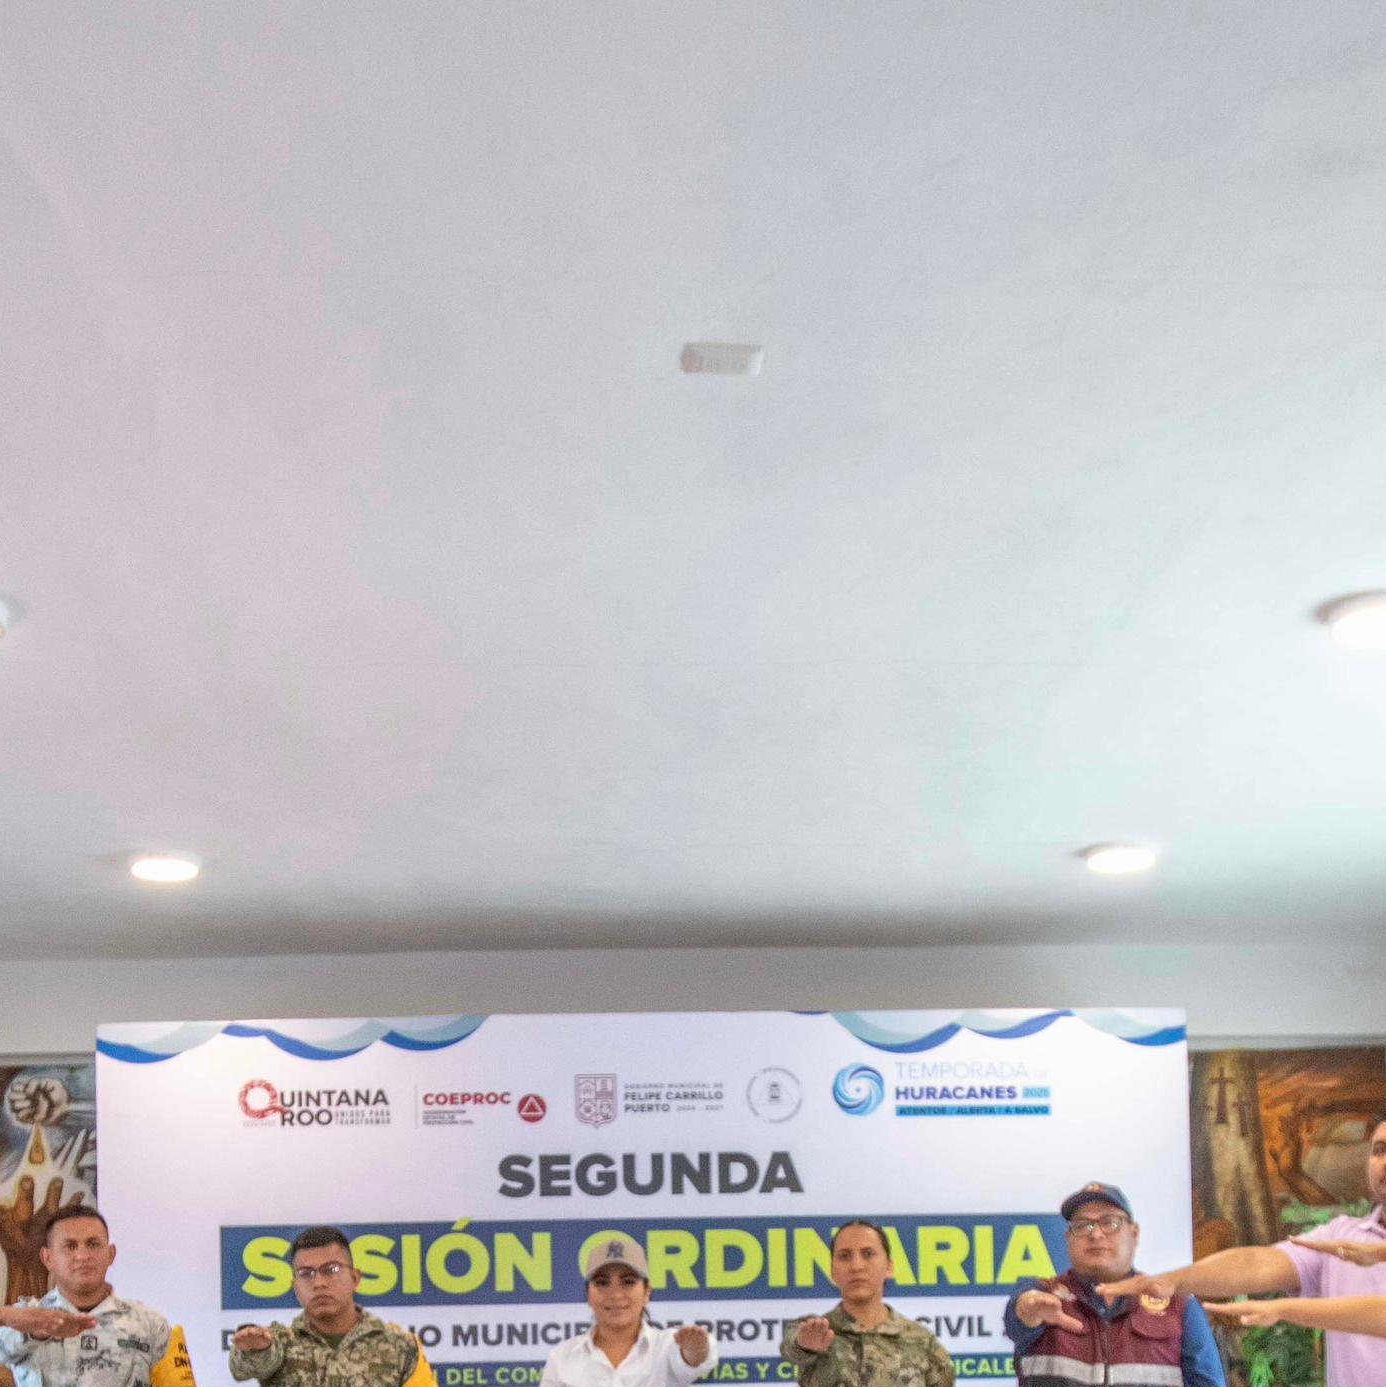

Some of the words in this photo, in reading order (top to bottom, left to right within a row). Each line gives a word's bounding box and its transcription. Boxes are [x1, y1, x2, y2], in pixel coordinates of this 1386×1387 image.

[895, 1062, 1029, 1080] TEMPORADA
[239, 1079, 390, 1119] QUINTANA
[423, 1091, 512, 1106] COEPROC
[624, 1091, 661, 1101] FELIPE
[665, 1091, 724, 1100] CARRILLO
[895, 1086, 1018, 1100] HURACANES
[624, 1103, 670, 1113] PUERTO
[956, 1106, 996, 1115] ALERTA
[280, 1108, 333, 1127] ROO
[498, 1151, 804, 1199] SEGUNDA
[241, 1217, 553, 1298] SSIÓN
[446, 1368, 487, 1385] DEL
[755, 1361, 771, 1380] Y
